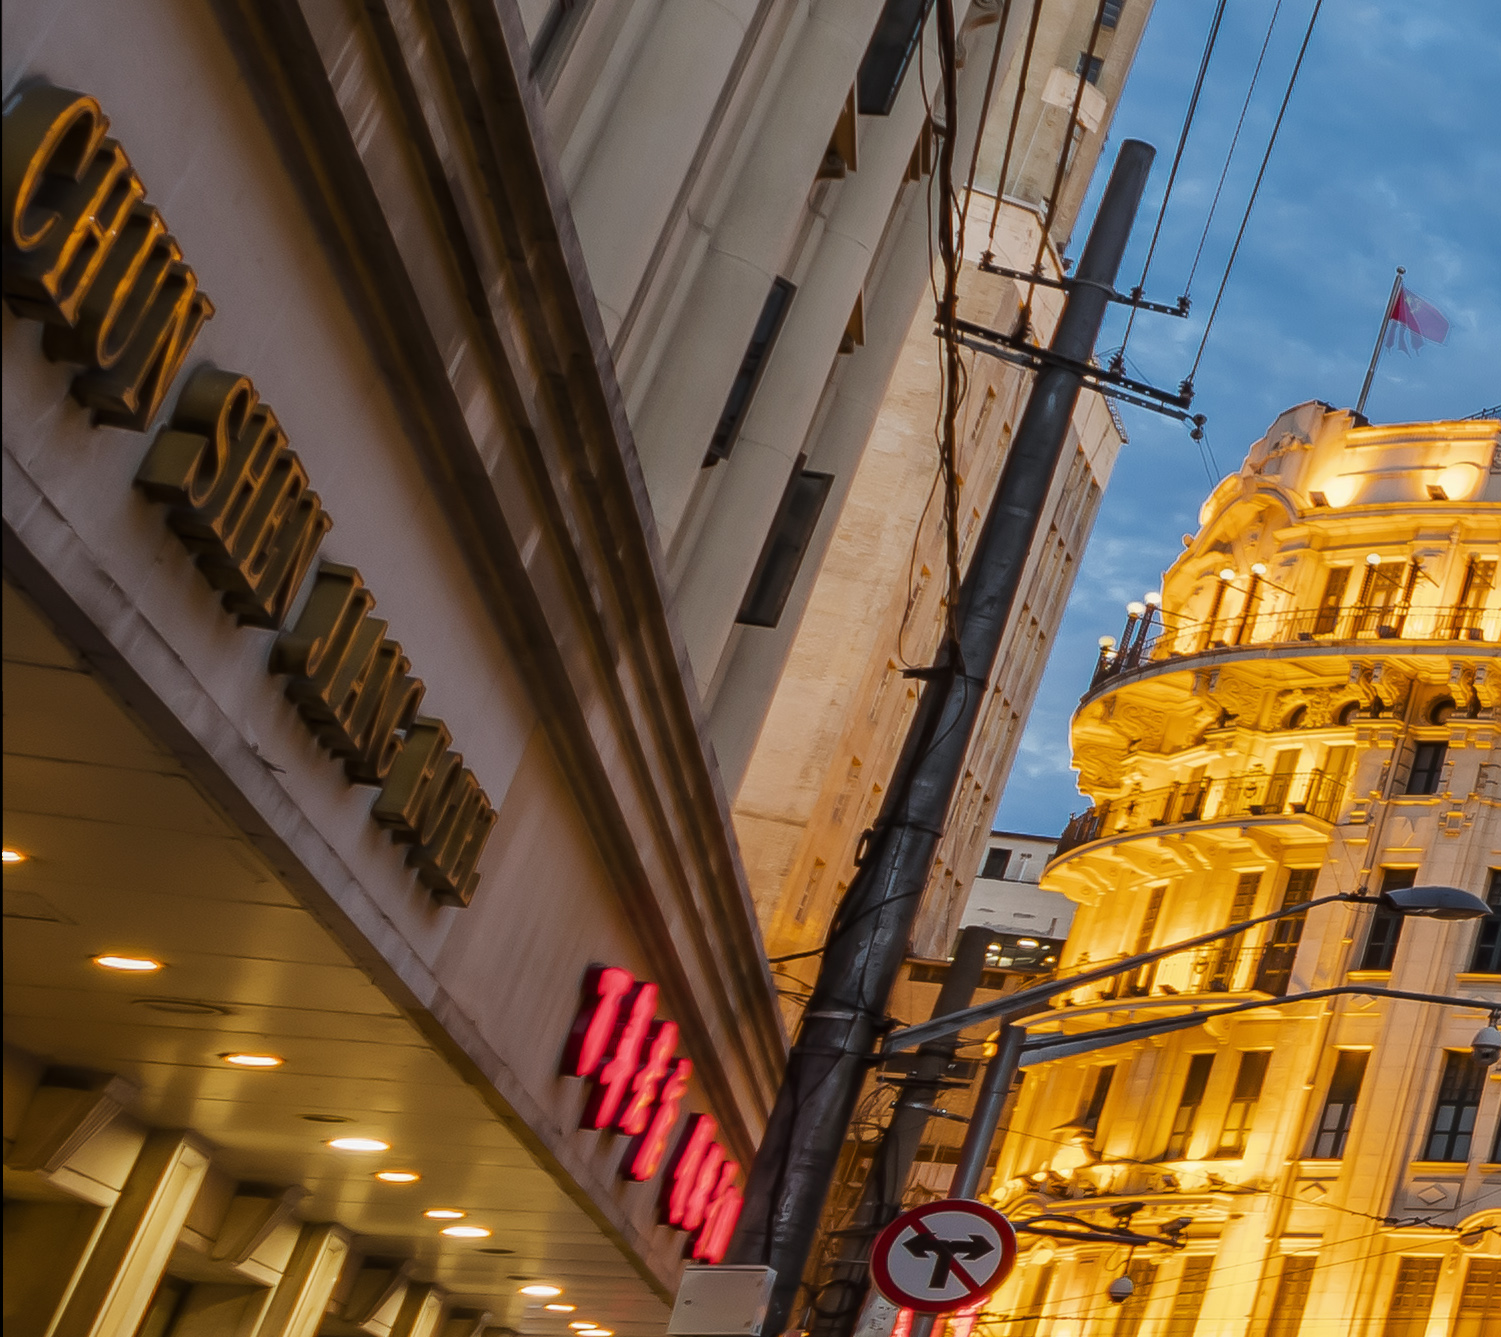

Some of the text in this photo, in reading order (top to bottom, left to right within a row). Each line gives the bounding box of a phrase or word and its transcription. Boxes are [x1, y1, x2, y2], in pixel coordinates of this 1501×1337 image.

[13, 95, 215, 432] CHUN
[184, 375, 334, 630] SHEN
[402, 717, 498, 908] HOTEL
